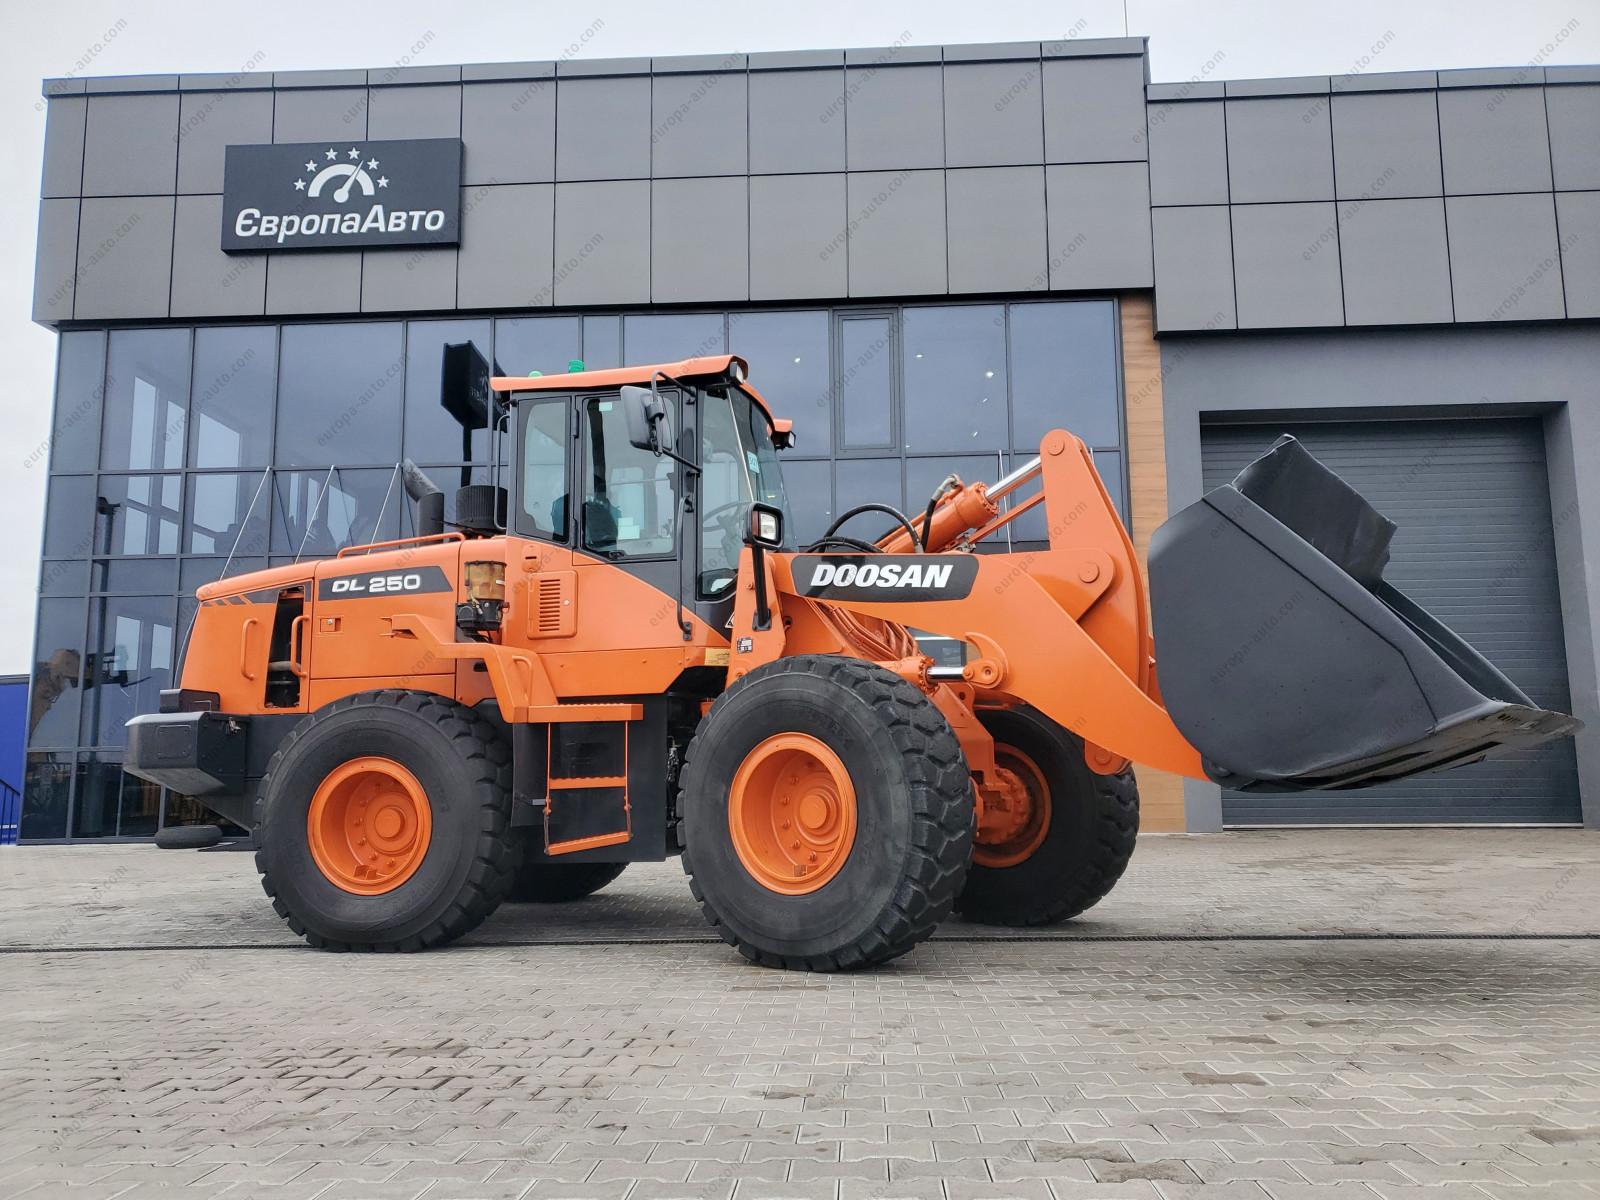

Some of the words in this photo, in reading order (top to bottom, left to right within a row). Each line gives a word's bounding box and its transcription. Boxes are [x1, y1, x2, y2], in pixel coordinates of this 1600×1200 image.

[235, 204, 445, 243] ЄвропаАвто
[332, 579, 366, 593] DL
[369, 574, 421, 593] 250
[810, 564, 954, 588] DOOSAN
